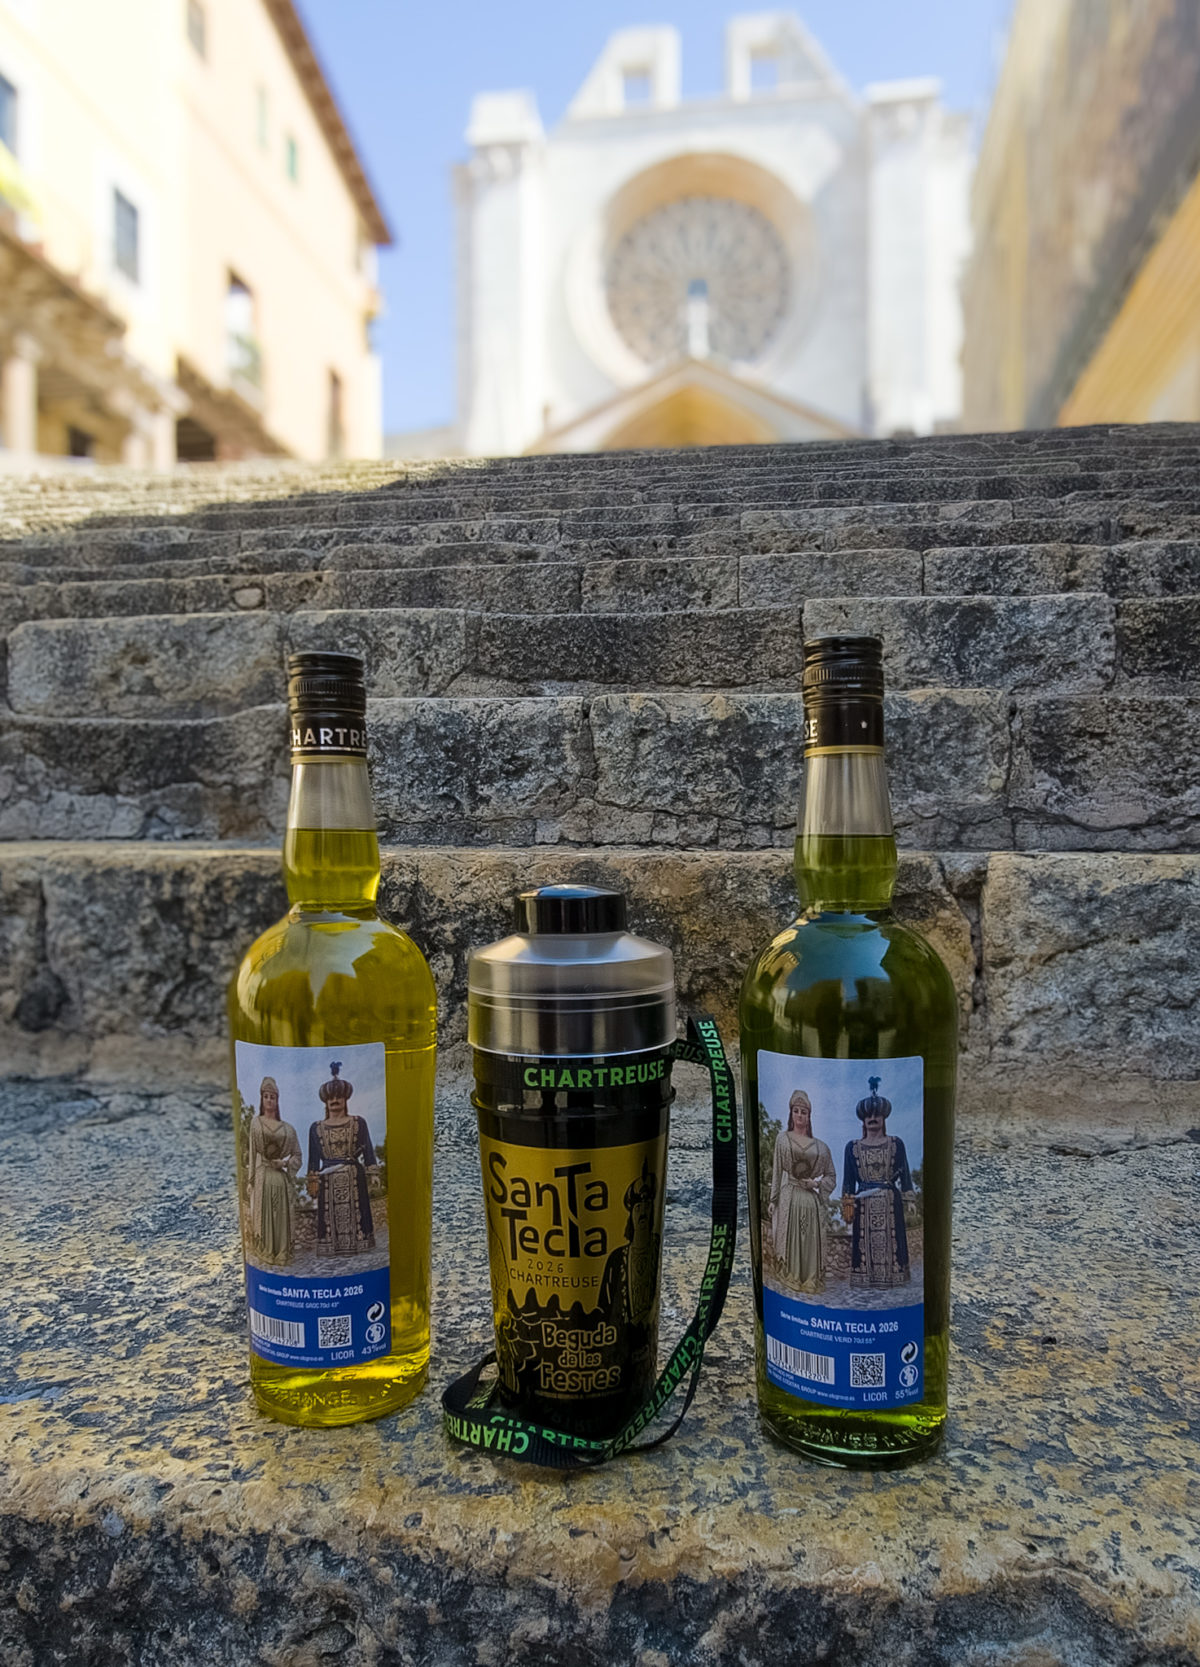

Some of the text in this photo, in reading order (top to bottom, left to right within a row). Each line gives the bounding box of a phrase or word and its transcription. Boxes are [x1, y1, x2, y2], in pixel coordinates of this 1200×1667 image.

[523, 1059, 665, 1088] CHARTREUSE
[697, 1019, 733, 1143] CHARTREUSE
[501, 1208, 608, 1261] Tecla
[527, 1258, 564, 1274] 2026
[509, 1267, 600, 1289] CHARTREUSE
[282, 1286, 310, 1299] SANTA
[312, 1286, 342, 1299] TECLA
[343, 1284, 364, 1297] 2026
[810, 1317, 843, 1332] SANTA
[845, 1322, 877, 1333] TECLA
[878, 1321, 899, 1333] 2026
[541, 1321, 618, 1353] Beguda
[330, 1349, 355, 1361] LICOR
[558, 1349, 602, 1368] de les
[863, 1391, 888, 1401] LICOR
